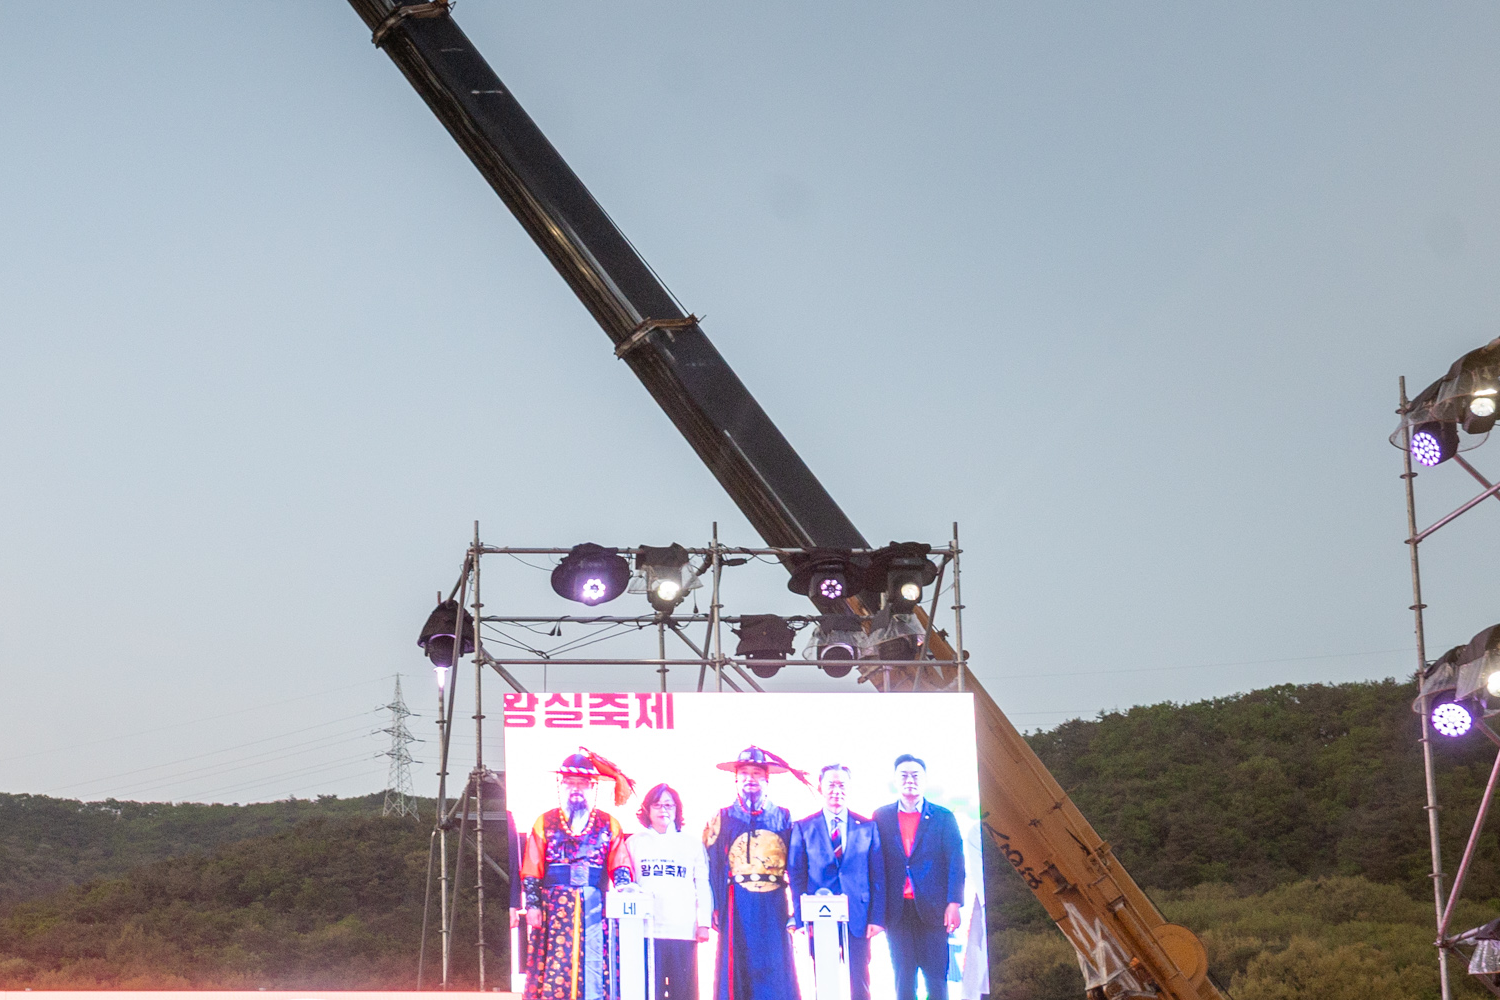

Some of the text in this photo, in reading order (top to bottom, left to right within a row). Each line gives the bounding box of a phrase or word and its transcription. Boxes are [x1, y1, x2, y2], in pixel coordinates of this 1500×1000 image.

[641, 862, 687, 877] 왕실축제
[623, 902, 636, 915] 네
[819, 905, 832, 918] 스
